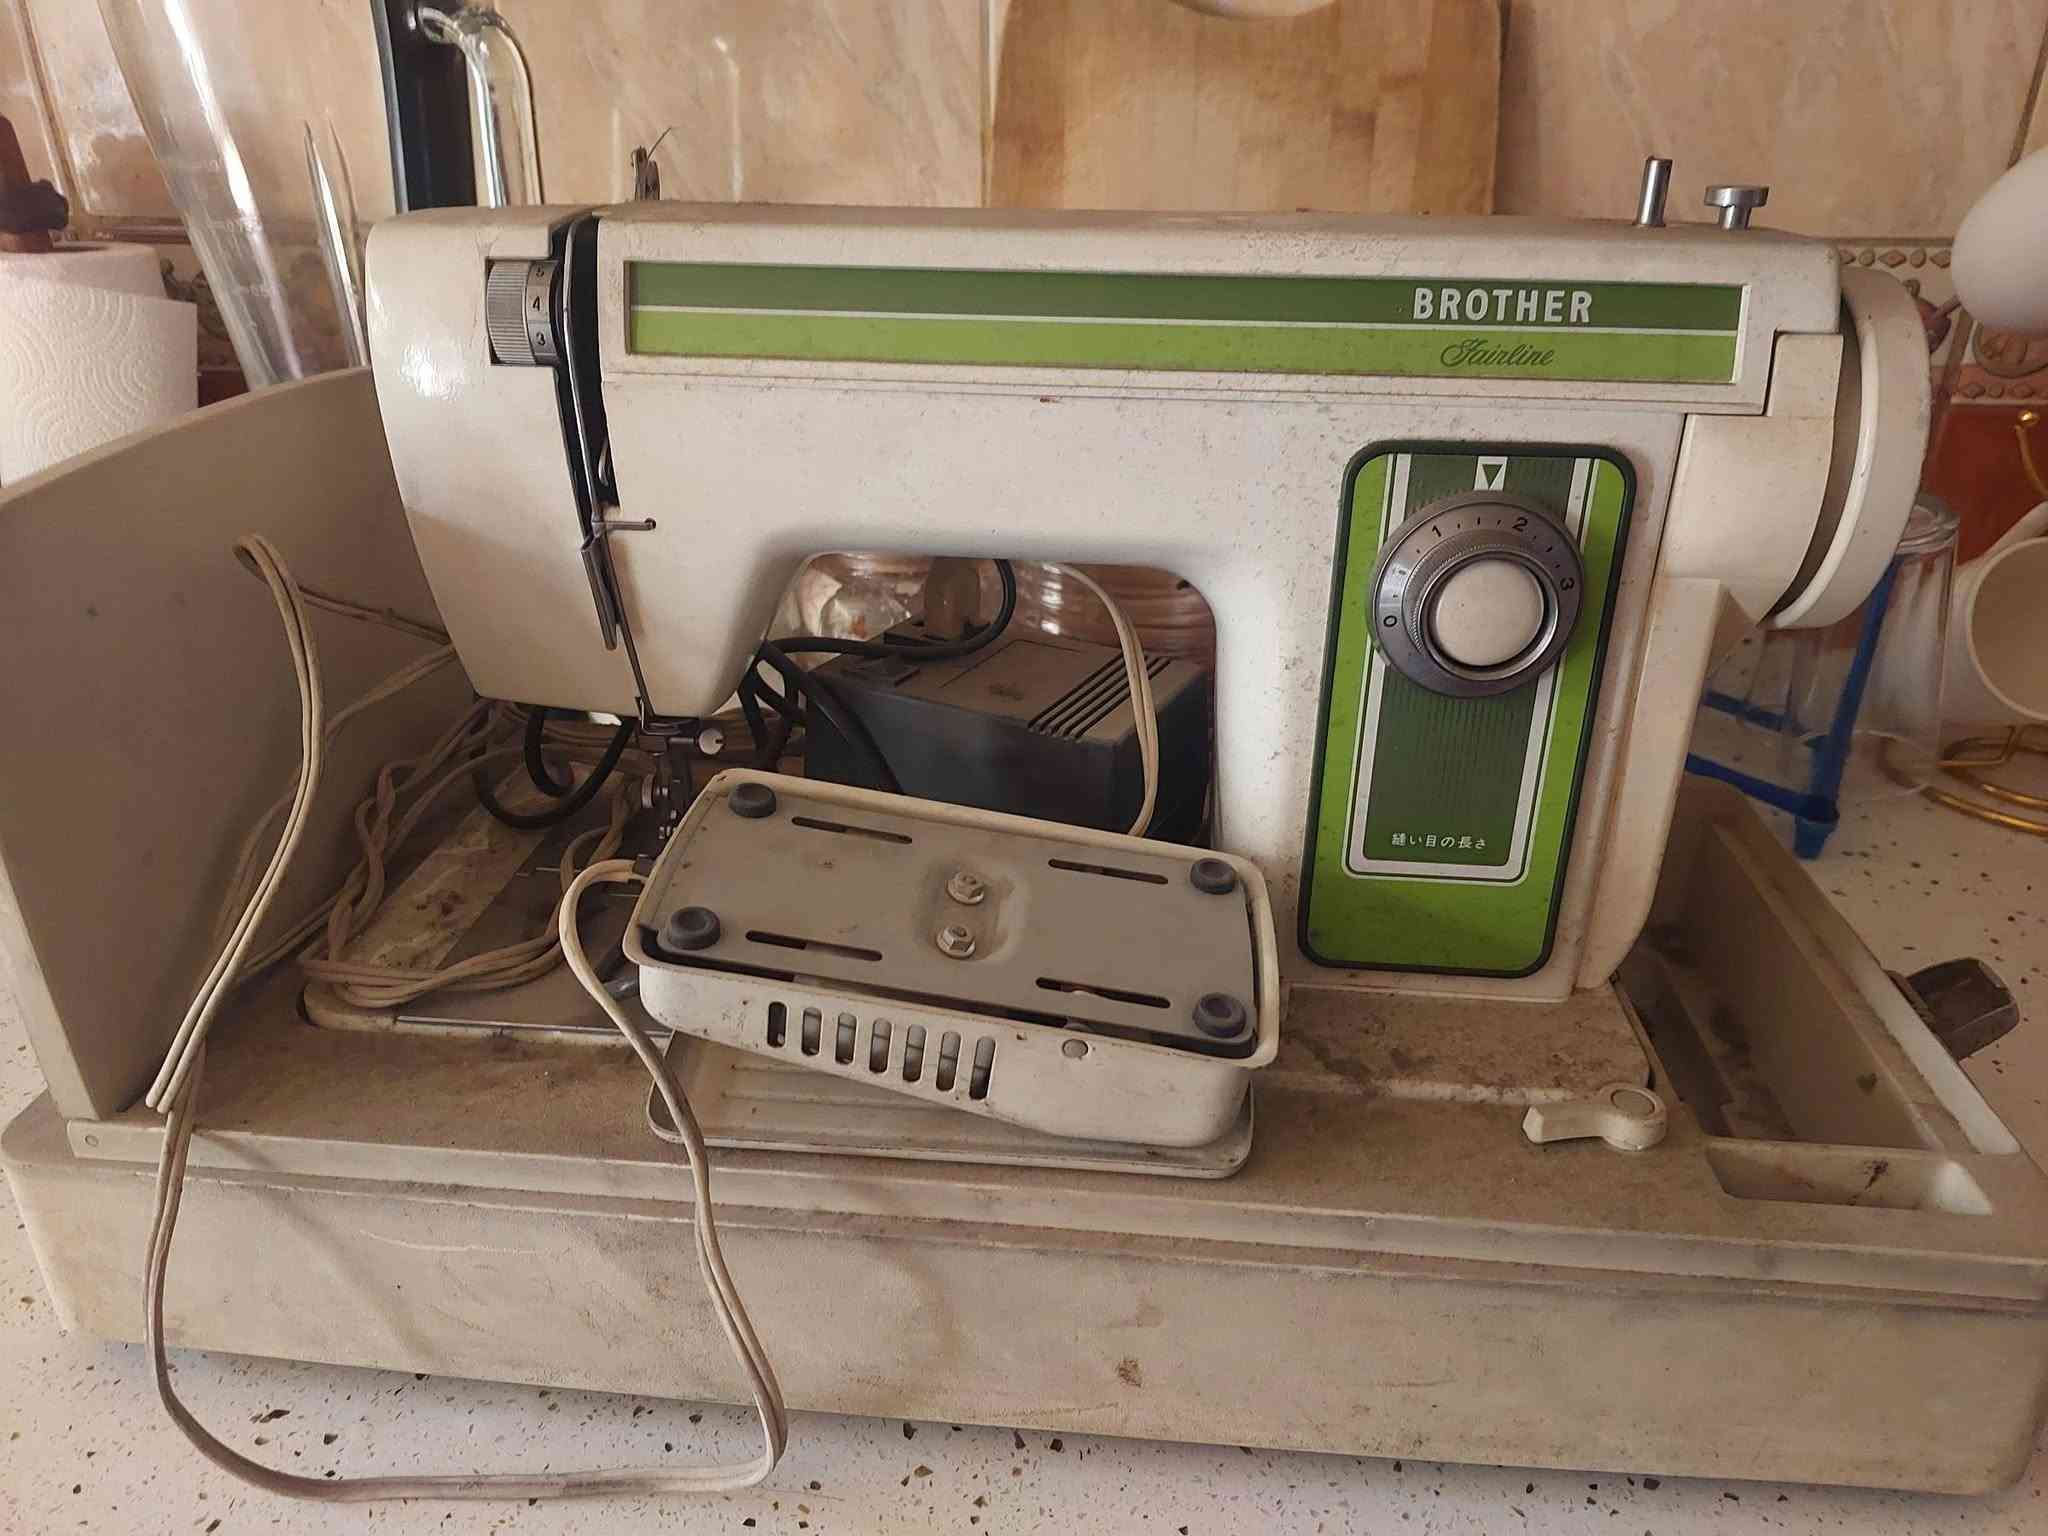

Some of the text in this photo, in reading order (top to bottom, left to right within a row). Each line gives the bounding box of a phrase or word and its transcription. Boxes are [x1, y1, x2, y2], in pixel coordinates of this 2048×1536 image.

[532, 295, 541, 312] 4
[1413, 287, 1592, 323] BROTHER
[536, 331, 546, 346] 3
[1441, 338, 1554, 367] Fairline
[1431, 525, 1443, 538] 1
[1512, 516, 1529, 532] 2
[1560, 577, 1575, 591] 3
[1383, 615, 1398, 628] 0
